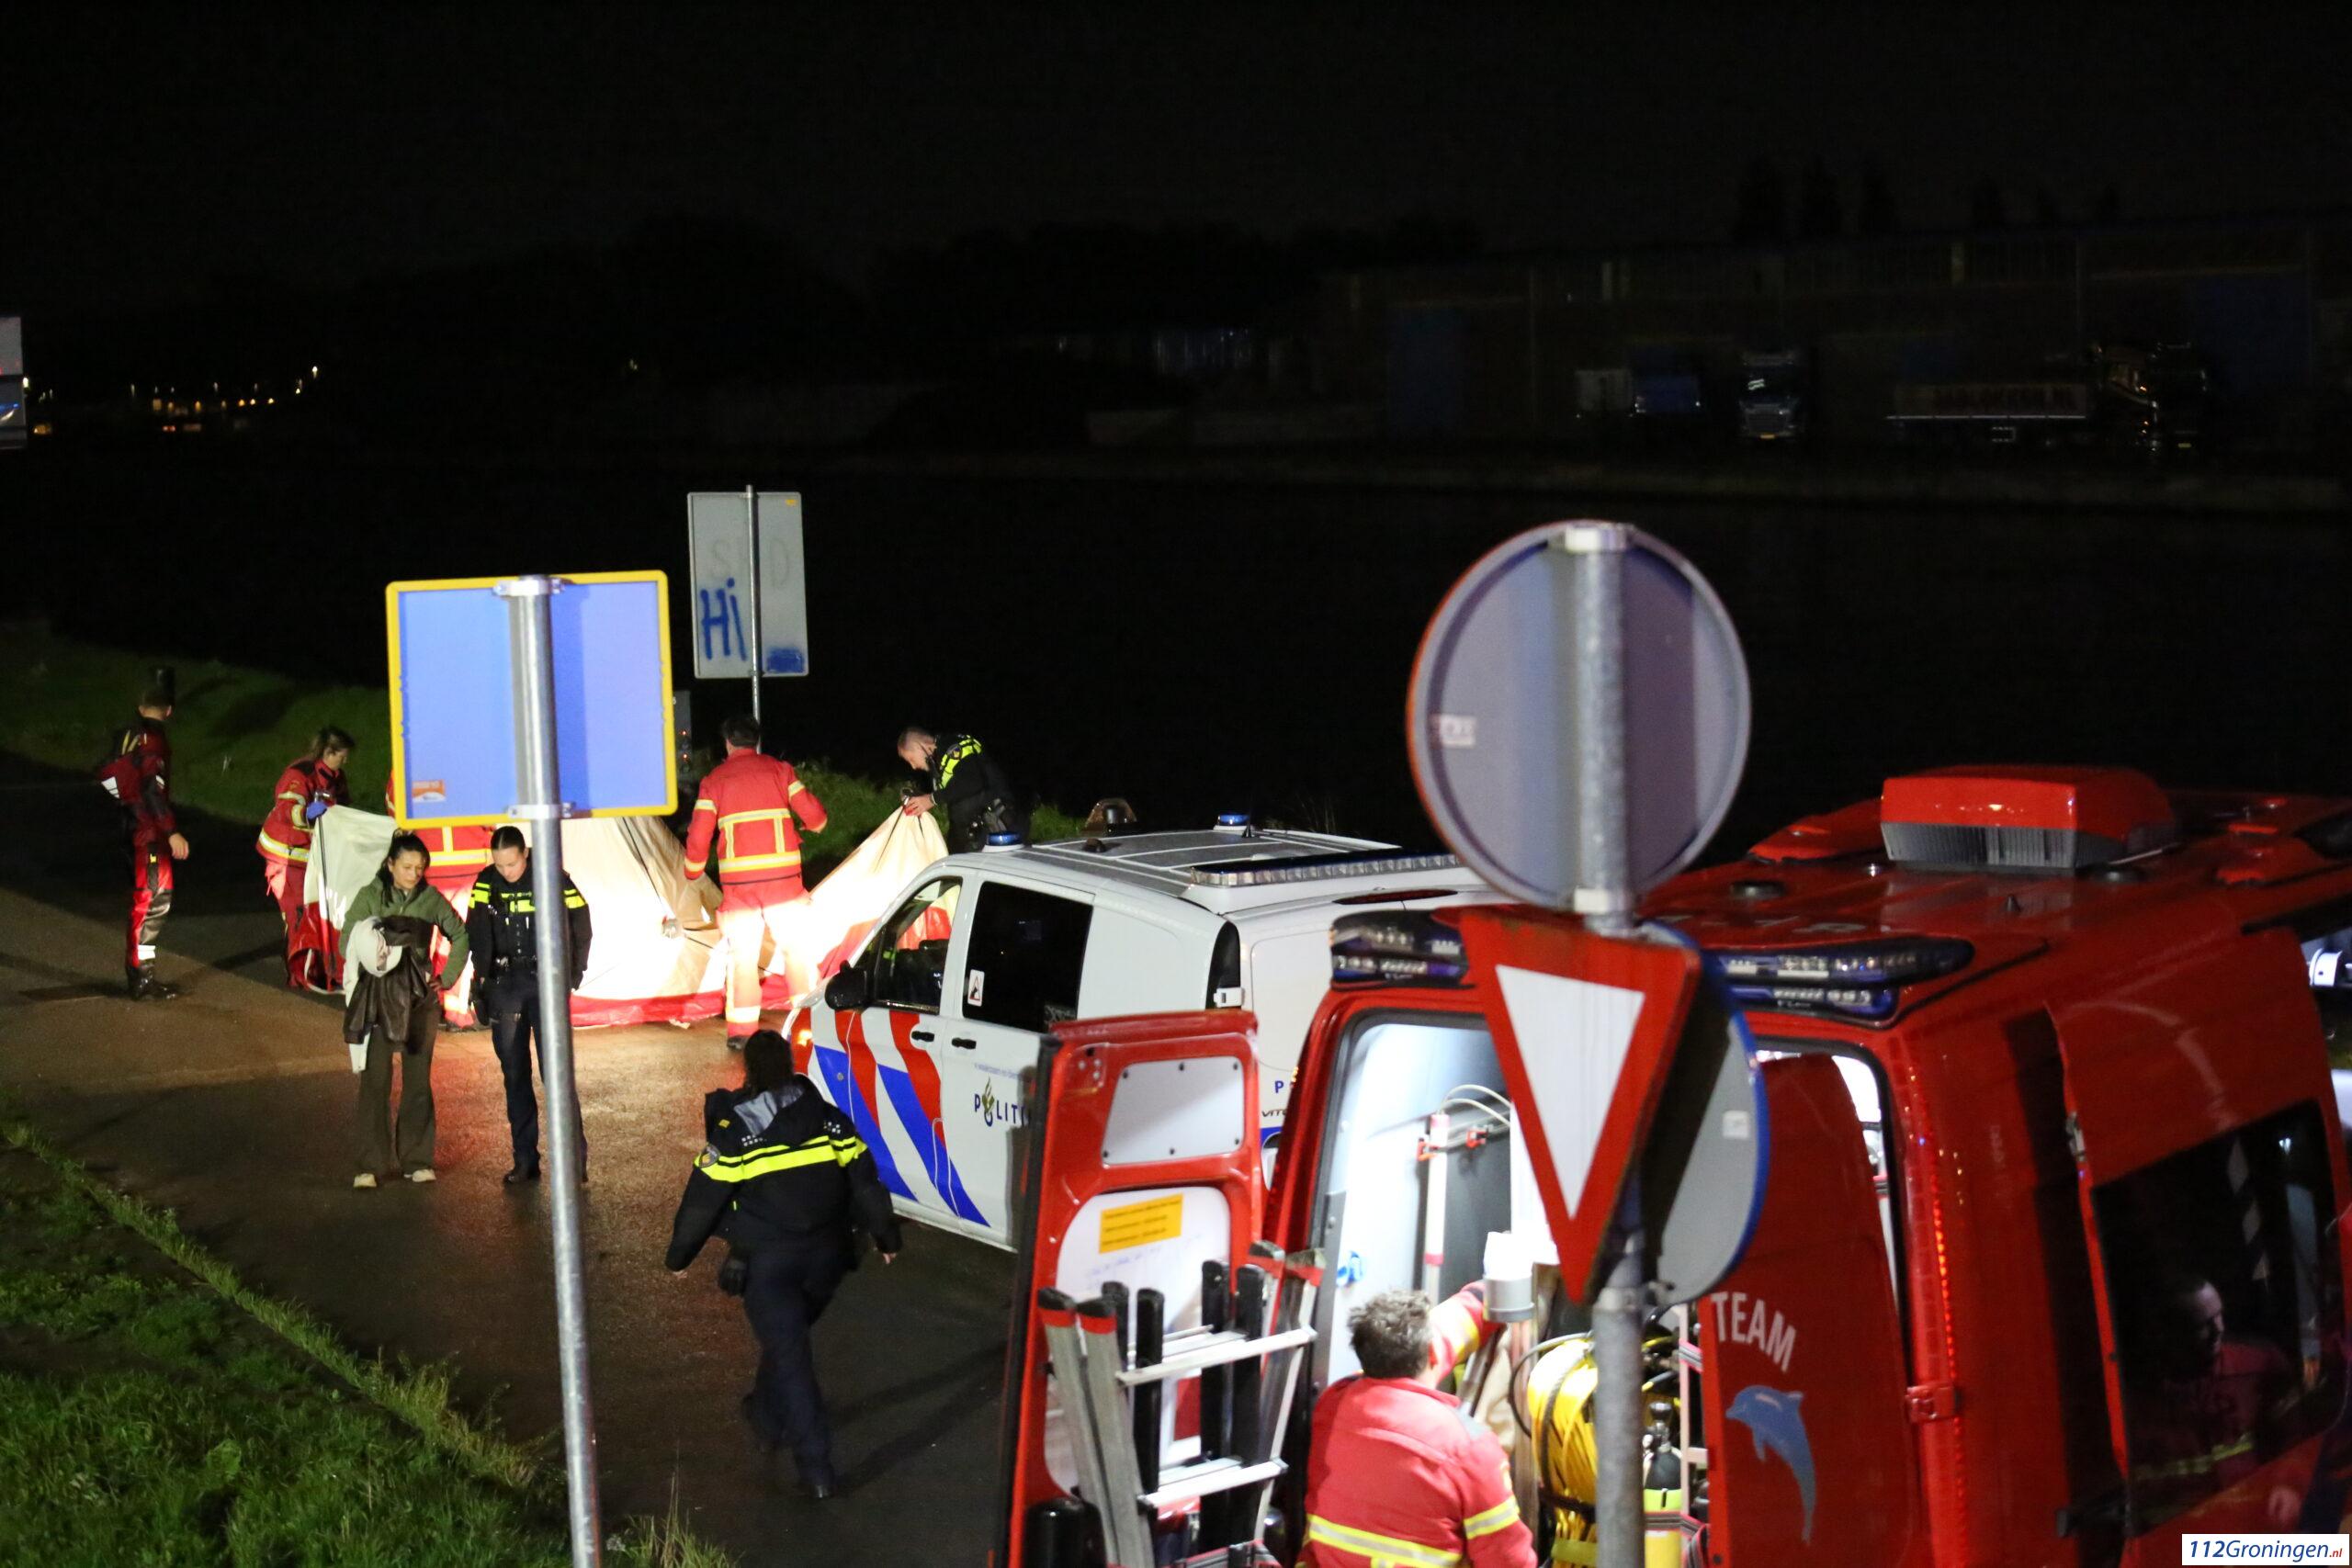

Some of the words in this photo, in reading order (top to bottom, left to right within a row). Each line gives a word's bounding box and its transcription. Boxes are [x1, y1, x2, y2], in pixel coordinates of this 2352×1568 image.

[700, 577, 747, 661] Hi
[974, 1093, 1031, 1127] POLITI
[1711, 1291, 1796, 1372] TEAM
